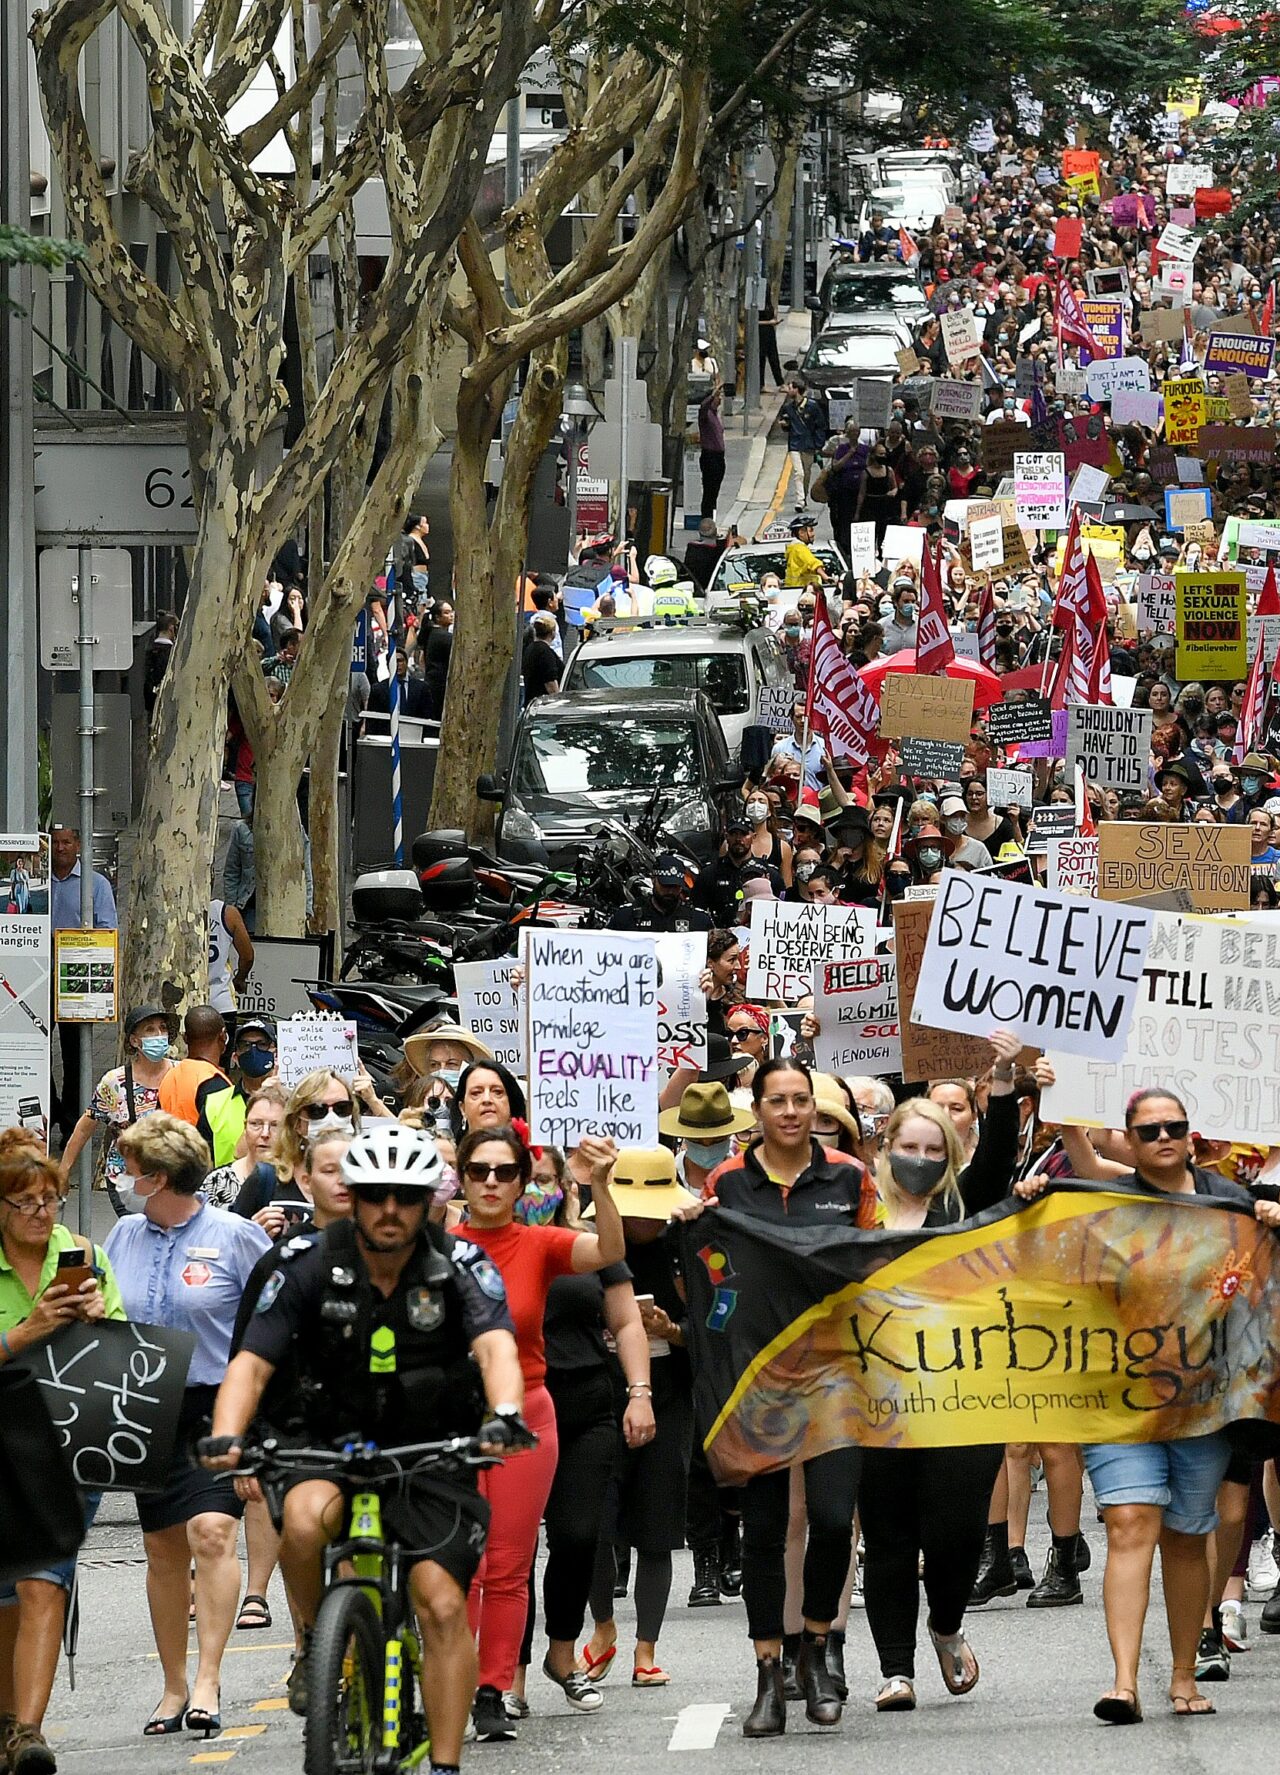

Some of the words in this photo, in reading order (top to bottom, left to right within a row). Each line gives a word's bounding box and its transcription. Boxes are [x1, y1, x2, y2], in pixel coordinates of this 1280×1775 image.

[1086, 313, 1116, 324] RIGHTS
[1092, 324, 1110, 335] ARE
[1212, 337, 1258, 352] ENOUGH
[1260, 341, 1271, 352] IS
[1208, 349, 1268, 368] ENOUGH!
[1164, 381, 1203, 398] FURIOUS
[1026, 455, 1043, 465] GOT
[1046, 454, 1062, 474] 99
[1141, 593, 1157, 604] ME
[1183, 585, 1213, 595] LET'S
[656, 596, 686, 606] POLICE
[1183, 596, 1239, 609] SEXUAL
[1144, 605, 1170, 620] TELL
[1183, 610, 1239, 621] VIOLENCE
[1185, 622, 1237, 640] NOW
[1185, 643, 1239, 653] #ibelieveher
[1076, 708, 1146, 733] SHOULDN'T
[1083, 731, 1114, 753] HAVE
[1119, 735, 1137, 756] TO
[1075, 755, 1099, 780] DO
[1104, 757, 1142, 784] THIS
[1135, 825, 1223, 862] SEX
[773, 903, 779, 919] I
[798, 904, 828, 923] AM
[846, 908, 859, 925] A
[11, 923, 42, 935] Street
[763, 918, 818, 941] HUMAN
[823, 923, 865, 945] BEING
[937, 876, 1148, 984] BELIEVE
[532, 937, 584, 968] When
[588, 947, 623, 976] you
[628, 952, 654, 971] are
[766, 939, 772, 954] I
[776, 939, 834, 958] DESERVE
[840, 944, 863, 960] TO
[758, 954, 777, 971] BE
[828, 964, 880, 990] HELL
[474, 991, 502, 1006] TOO
[533, 971, 630, 1006] accustomed
[635, 973, 655, 1007] to
[942, 958, 1126, 1040] WOMEN
[471, 1018, 493, 1033] BIG
[532, 1007, 607, 1053] privilege
[538, 1048, 653, 1083] EQUALITY
[533, 1077, 580, 1110] feels
[596, 1083, 636, 1114] like
[72, 1322, 168, 1487] Porter
[867, 1380, 937, 1427] youth
[942, 1378, 1110, 1424] development
